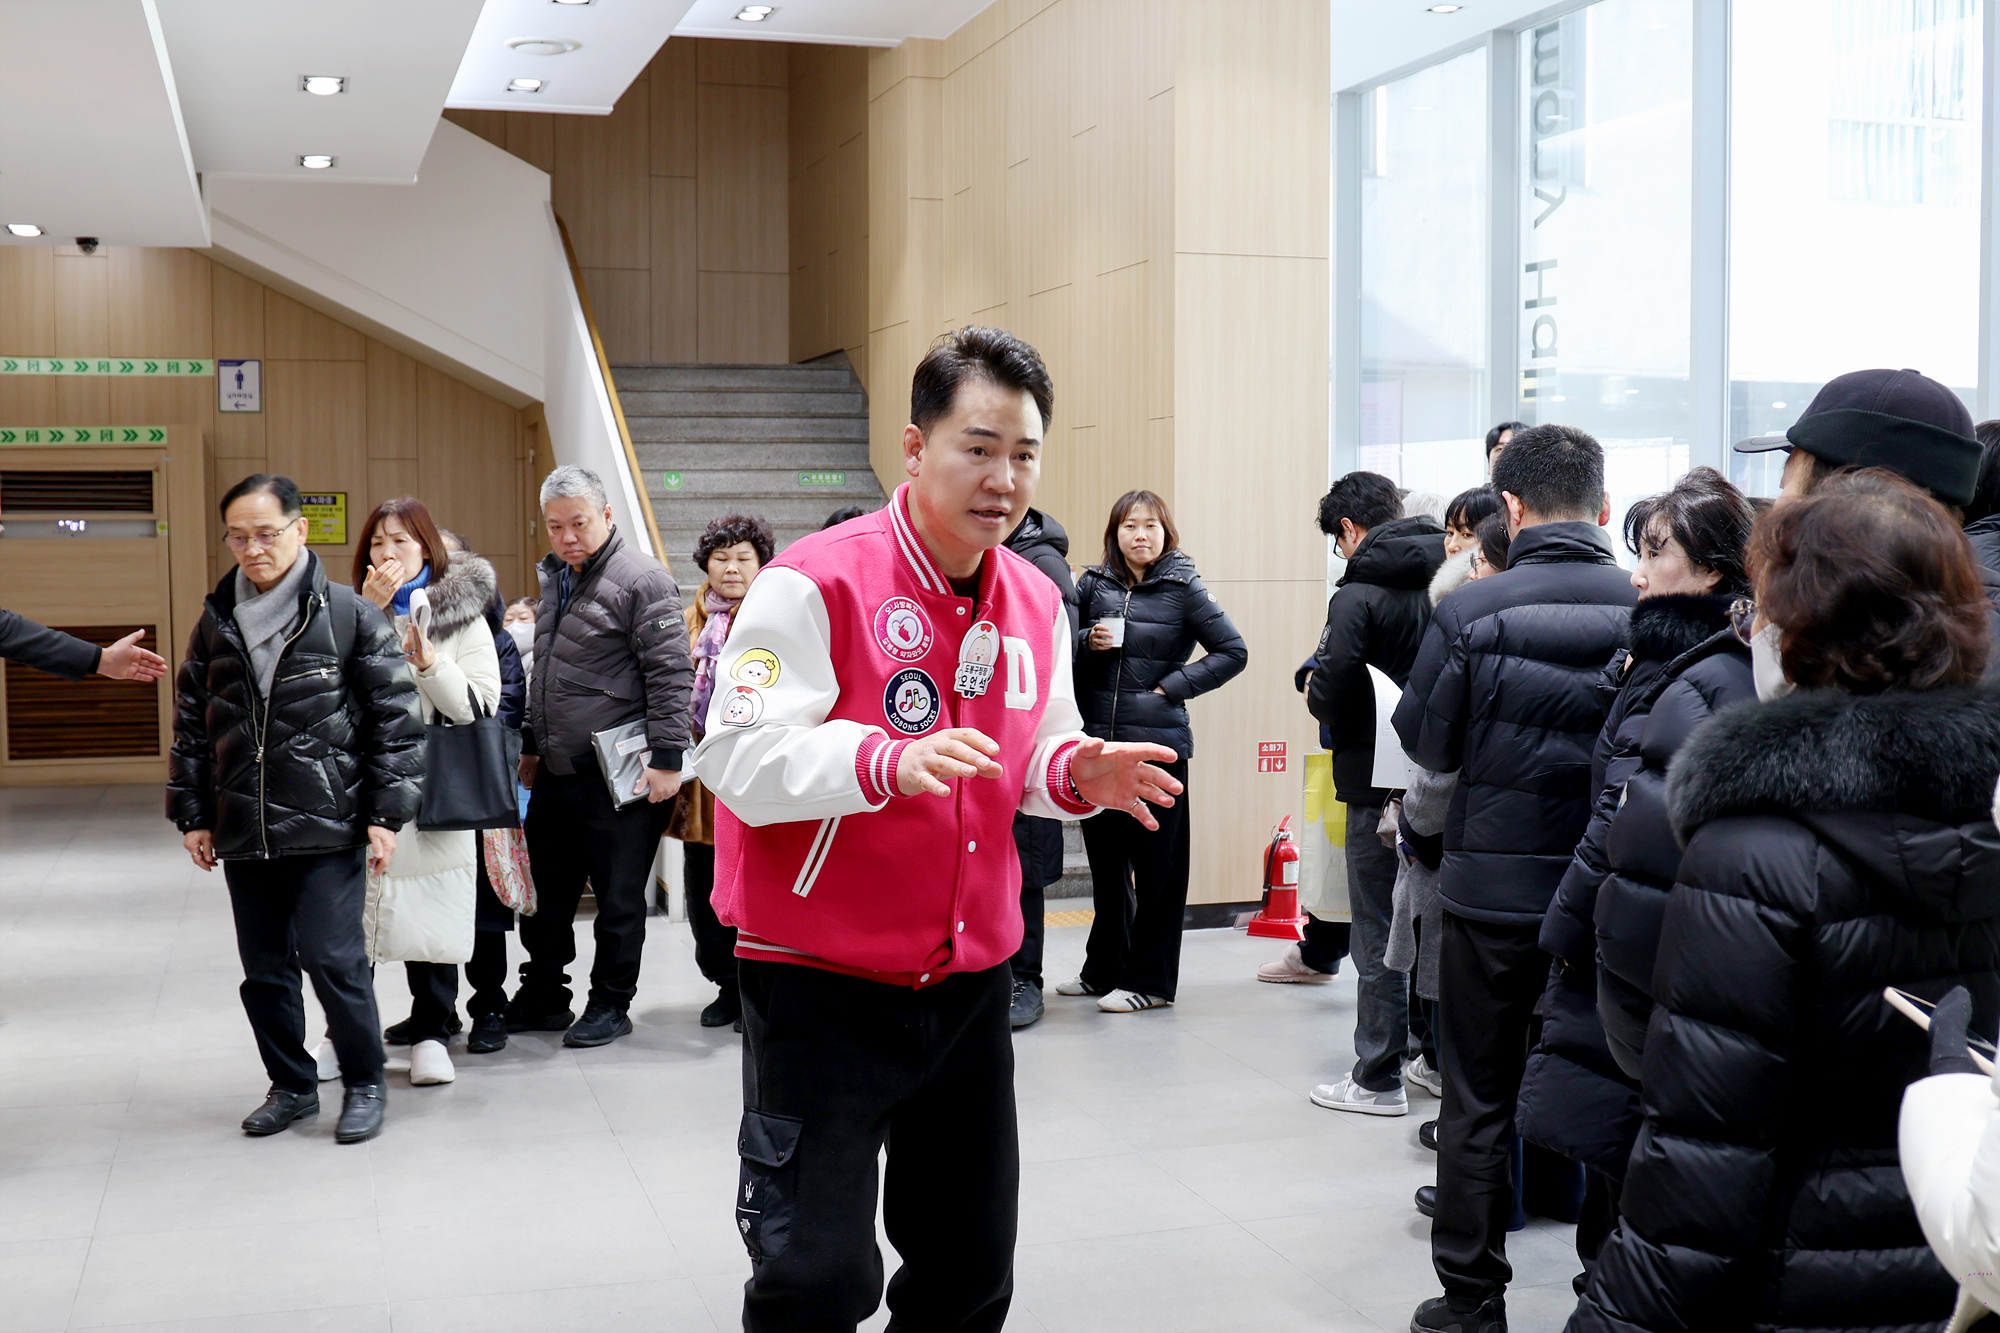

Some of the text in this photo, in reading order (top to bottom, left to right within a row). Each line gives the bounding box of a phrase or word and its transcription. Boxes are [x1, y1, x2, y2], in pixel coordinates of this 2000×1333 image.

[900, 672, 922, 682] SEOUL
[964, 664, 988, 676] 도봉구청장
[1002, 635, 1038, 711] D
[959, 675, 987, 691] 오언석
[890, 709, 937, 731] DOBONG SOCKS
[1261, 743, 1284, 752] 소화기
